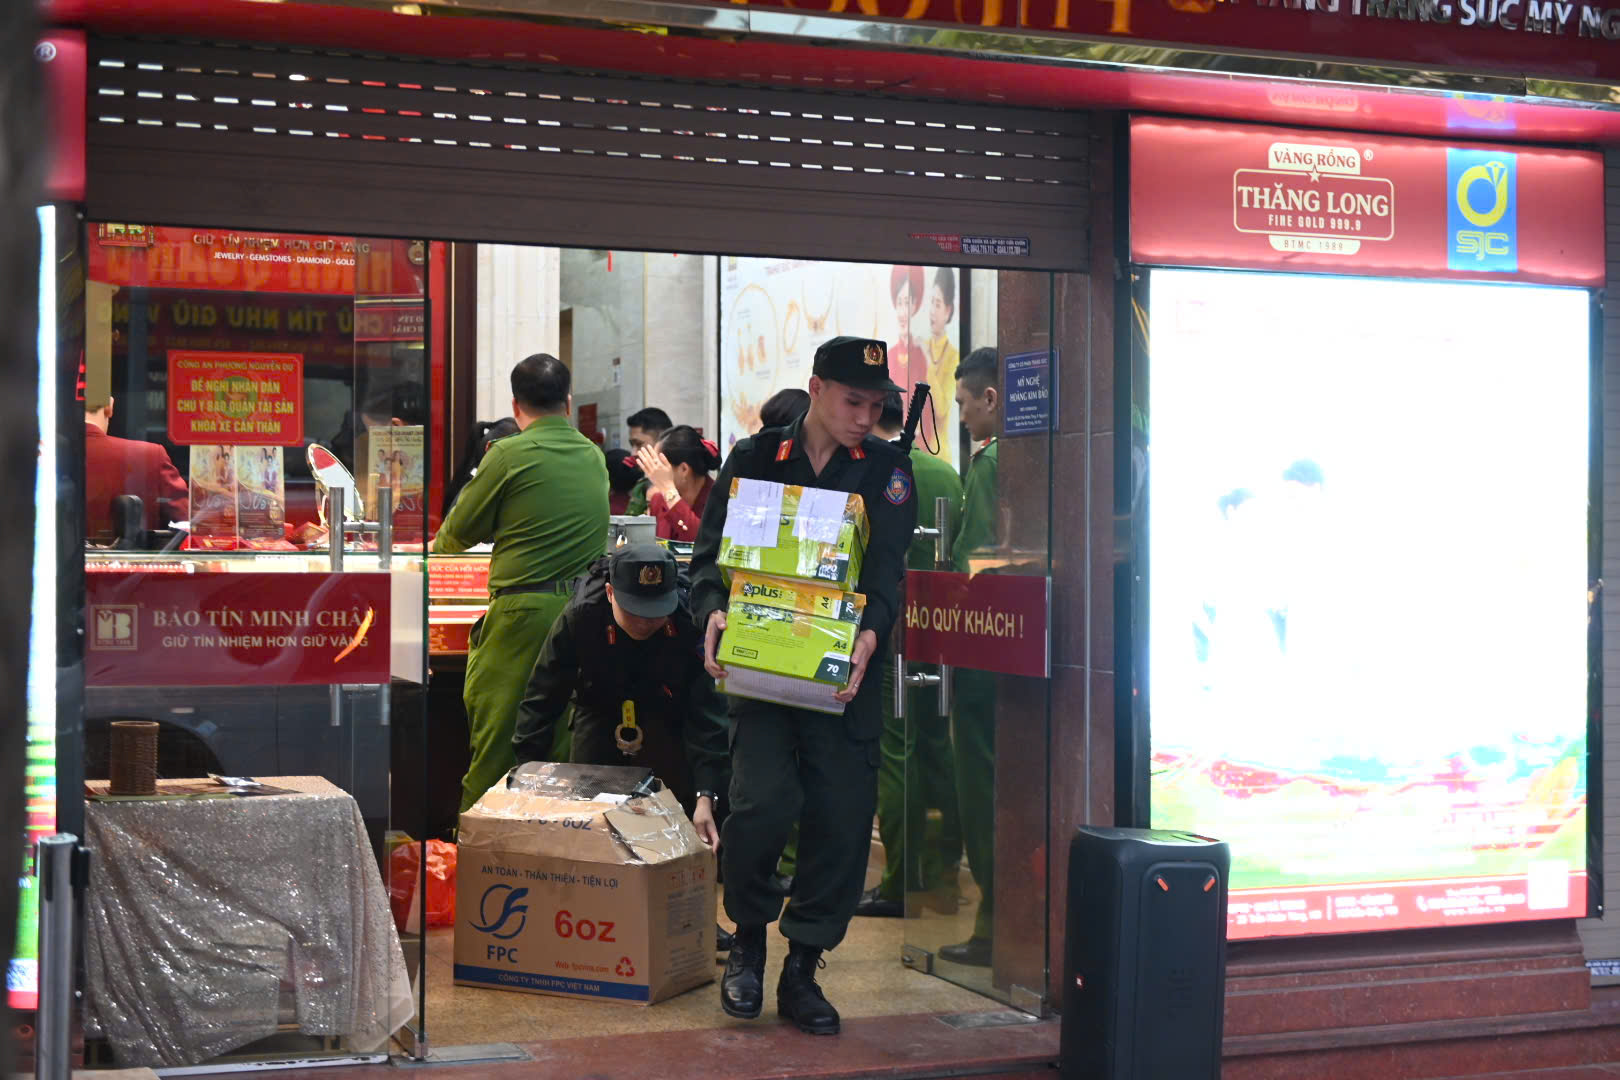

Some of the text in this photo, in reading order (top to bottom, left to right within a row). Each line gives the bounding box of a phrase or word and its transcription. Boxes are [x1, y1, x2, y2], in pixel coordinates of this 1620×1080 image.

[1273, 148, 1356, 169] VÀNG RỒNG
[1238, 182, 1389, 217] THĂNG LONG
[1268, 214, 1362, 231] FINE GOLD 999.9
[213, 251, 356, 266] JEWELRY GEMSTONES DIAMOND GOLD
[153, 606, 199, 627] BẢO
[208, 605, 244, 627] TÍN
[250, 609, 310, 627] MINH
[932, 604, 961, 632] QUÝ
[964, 605, 1015, 638] KHÁCH
[162, 634, 191, 648] GIỮ
[194, 634, 214, 648] TÍN
[217, 634, 263, 649] NHIỆM
[265, 634, 298, 648] HƠN
[301, 634, 329, 648] GIỮ
[833, 639, 847, 650] A4
[826, 662, 840, 674] 70
[481, 865, 493, 874] AN
[495, 865, 518, 877] TOÀN
[554, 909, 616, 943] 6oz
[487, 944, 518, 964] FPC
